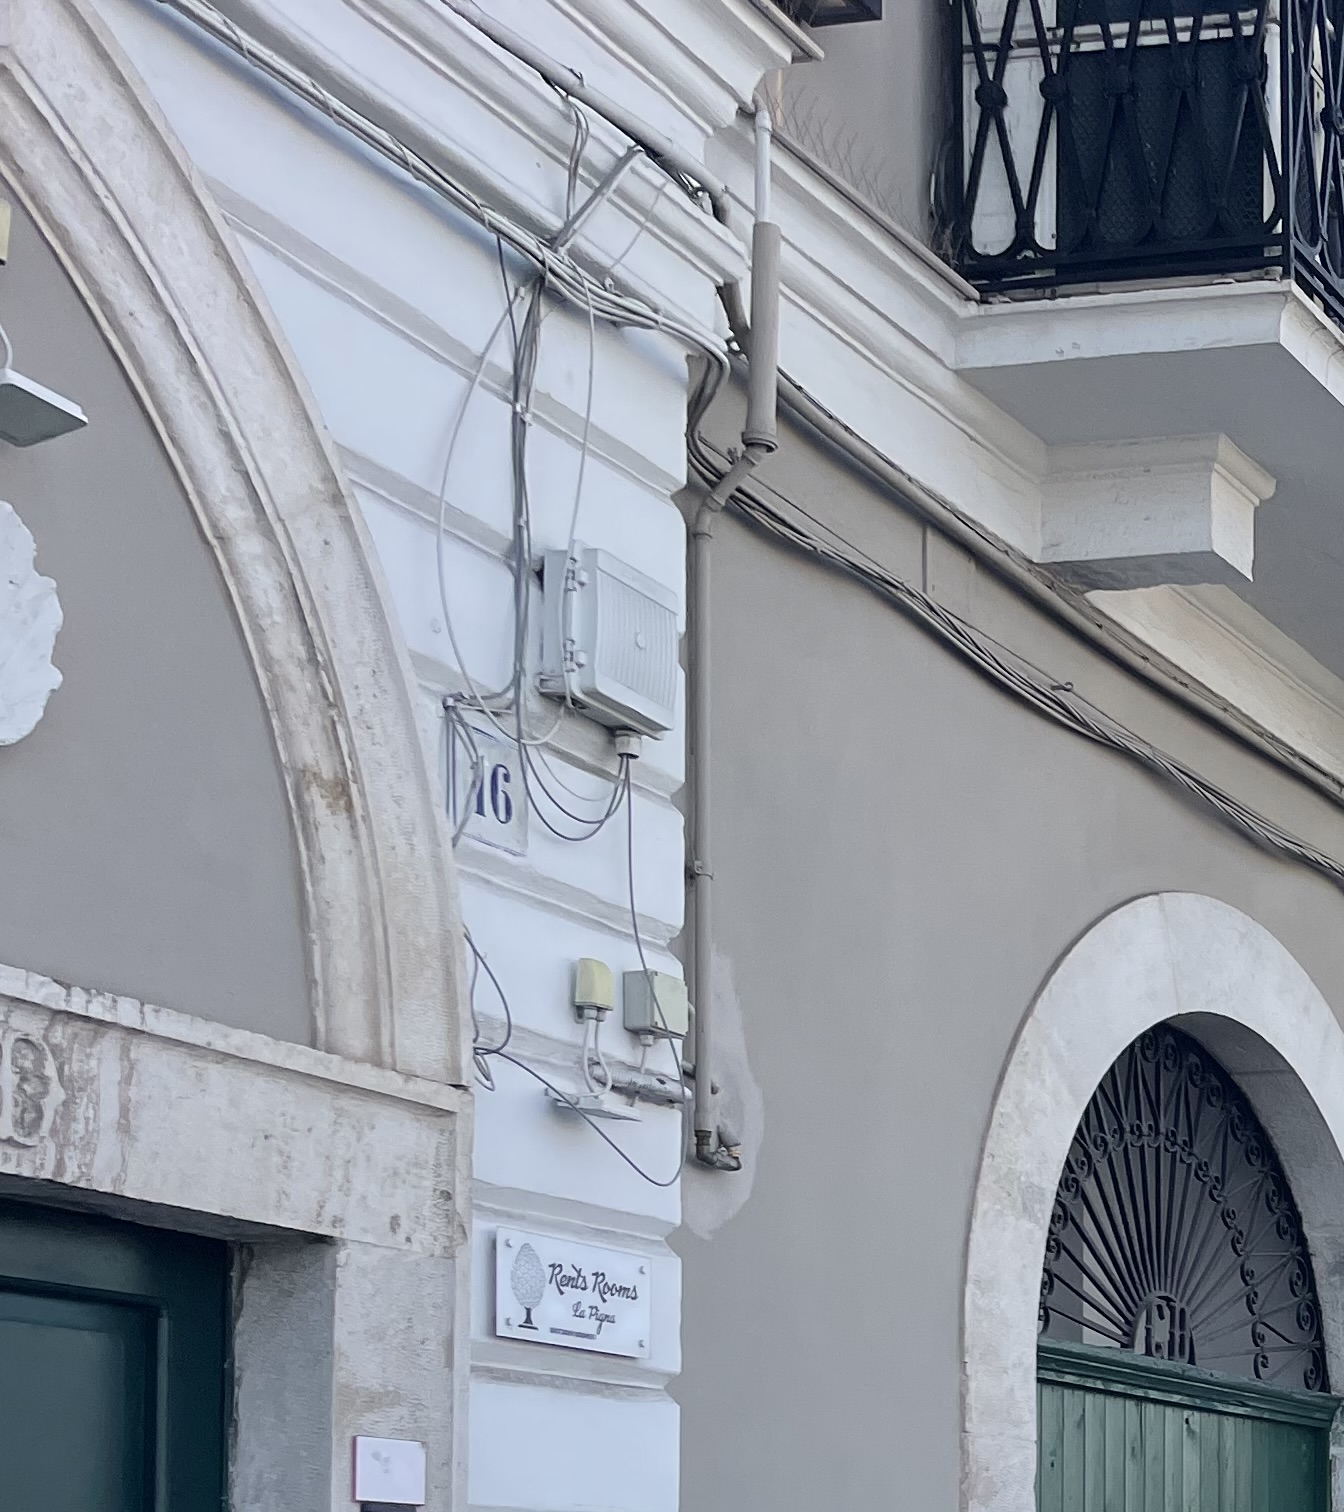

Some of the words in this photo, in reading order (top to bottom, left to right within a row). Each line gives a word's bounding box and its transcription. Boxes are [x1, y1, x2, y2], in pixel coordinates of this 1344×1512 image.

[474, 757, 513, 824] 16
[548, 1263, 588, 1295] Rents
[592, 1271, 638, 1303] Rooms
[572, 1301, 586, 1319] La
[588, 1305, 616, 1335] Pigna
